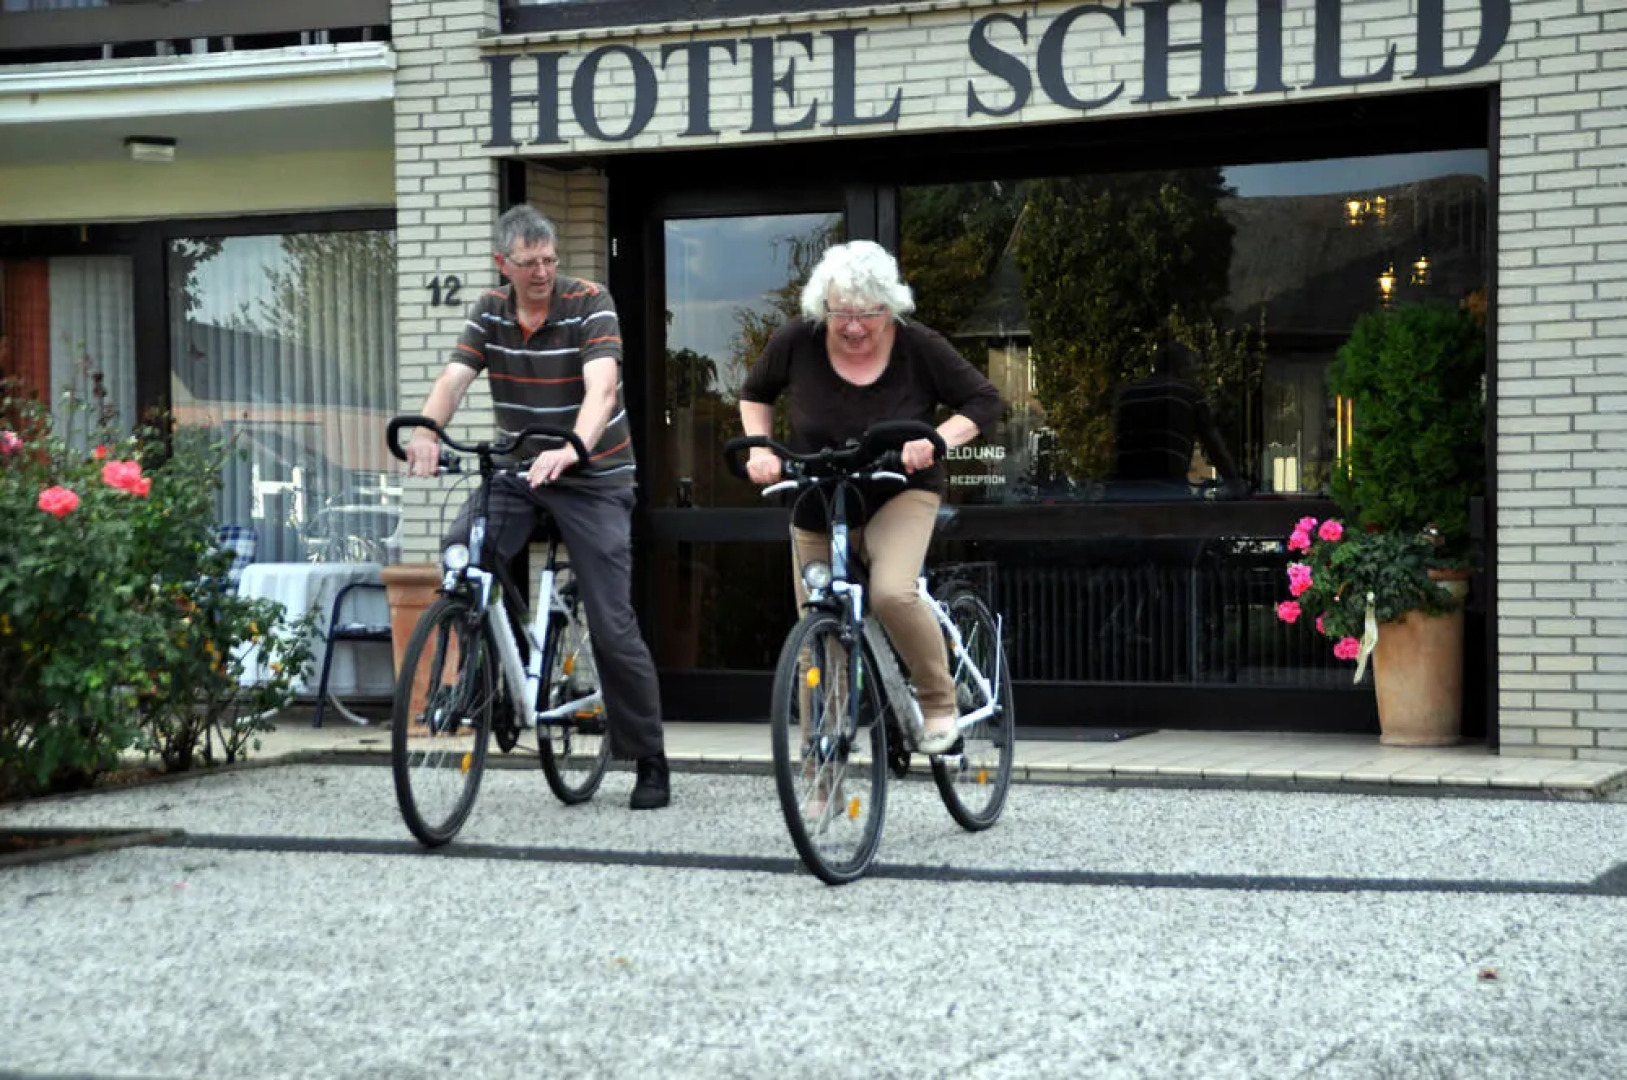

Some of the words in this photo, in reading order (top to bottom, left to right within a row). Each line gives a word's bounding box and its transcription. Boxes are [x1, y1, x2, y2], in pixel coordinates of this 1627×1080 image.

[480, 28, 902, 148] HOTEL
[967, 0, 1511, 117] SCHILD
[425, 275, 462, 306] 12
[941, 446, 1006, 460] ELDUNG
